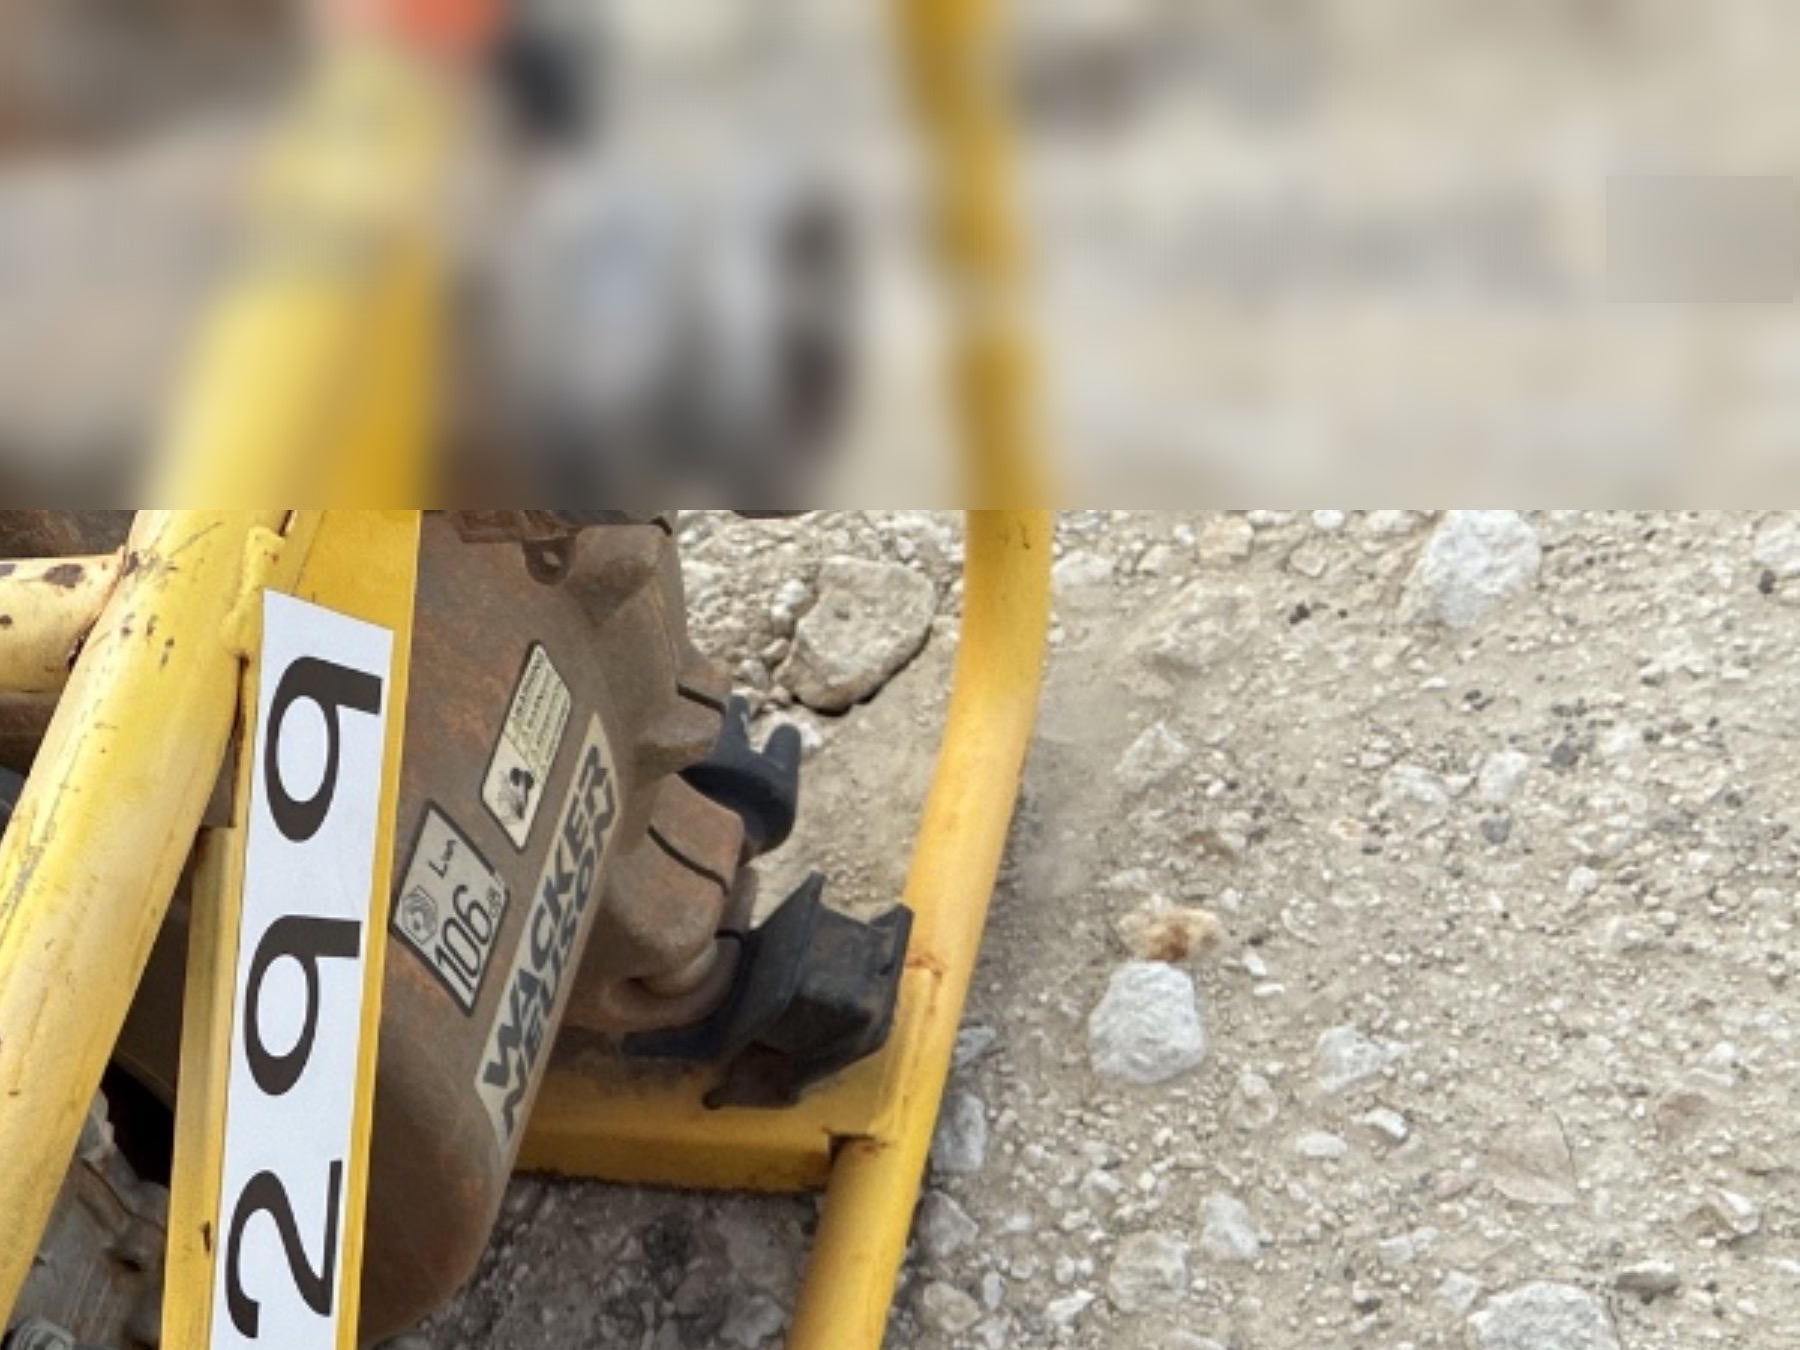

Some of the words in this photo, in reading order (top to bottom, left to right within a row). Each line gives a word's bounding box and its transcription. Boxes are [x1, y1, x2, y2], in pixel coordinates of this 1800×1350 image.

[435, 884, 492, 994] 106
[484, 745, 608, 1089] WACKER
[502, 777, 616, 1138] NEUSON
